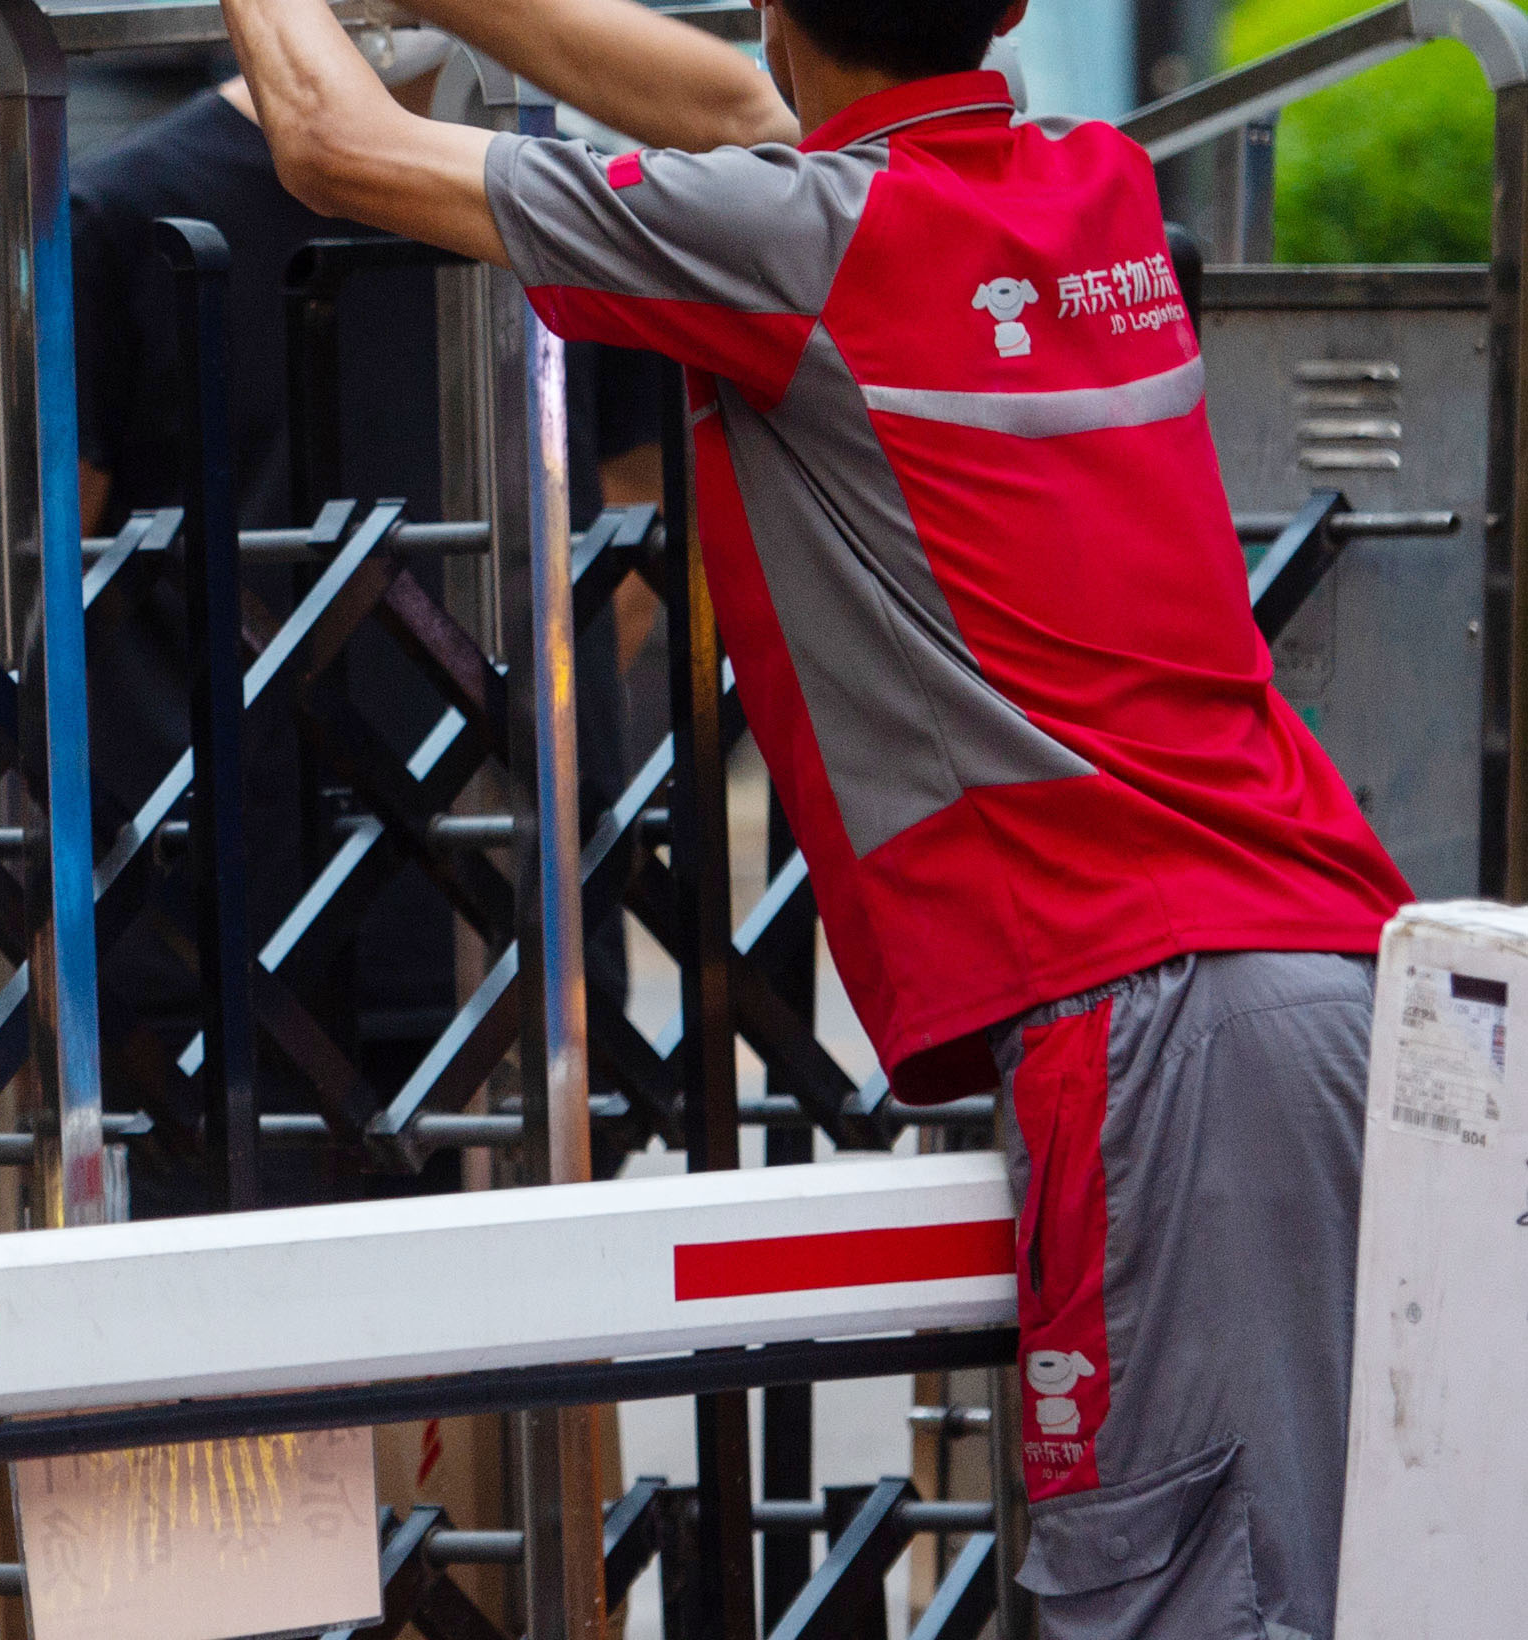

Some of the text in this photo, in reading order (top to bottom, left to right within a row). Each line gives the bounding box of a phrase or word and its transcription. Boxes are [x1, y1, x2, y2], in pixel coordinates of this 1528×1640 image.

[1057, 252, 1178, 320] 京东物流
[1110, 303, 1185, 335] JD Logistics
[1025, 1440, 1088, 1465] 京东物
